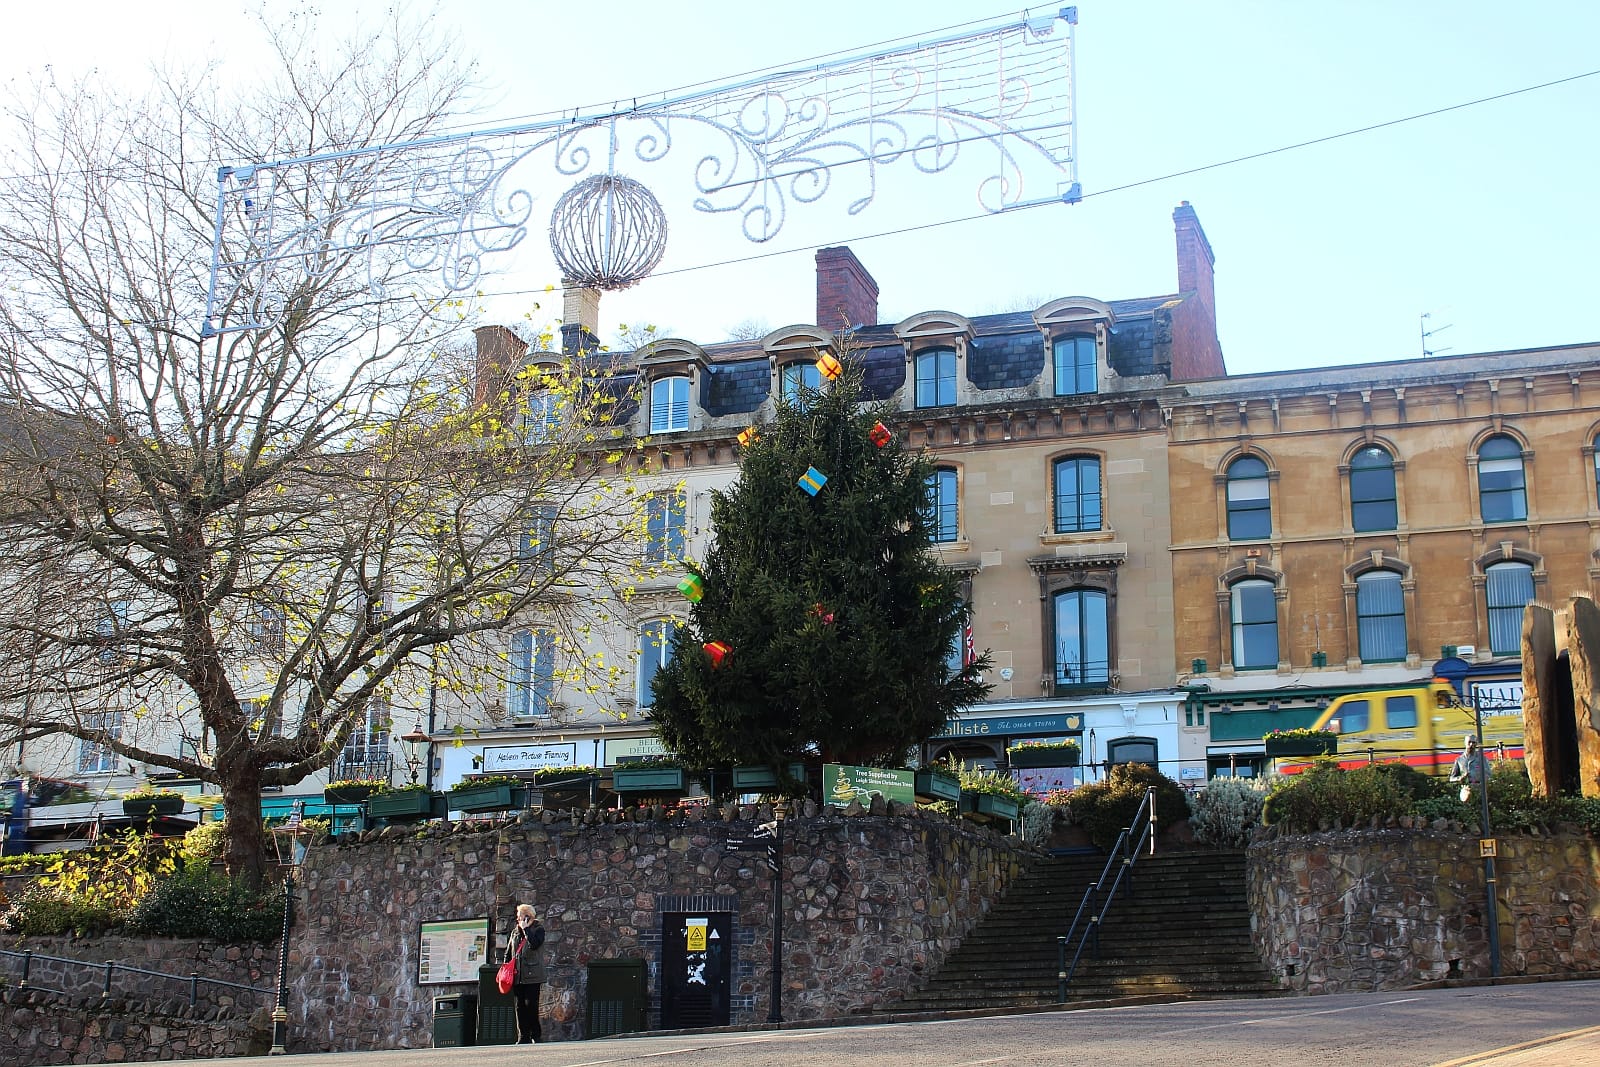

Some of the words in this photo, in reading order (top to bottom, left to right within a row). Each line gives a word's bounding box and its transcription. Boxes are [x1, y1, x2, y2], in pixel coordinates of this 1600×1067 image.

[938, 721, 990, 736] allistê
[629, 746, 664, 754] DELICA
[520, 751, 542, 760] Picture
[544, 750, 569, 761] Framing
[855, 769, 867, 777] Tree
[868, 771, 890, 779] Supplied
